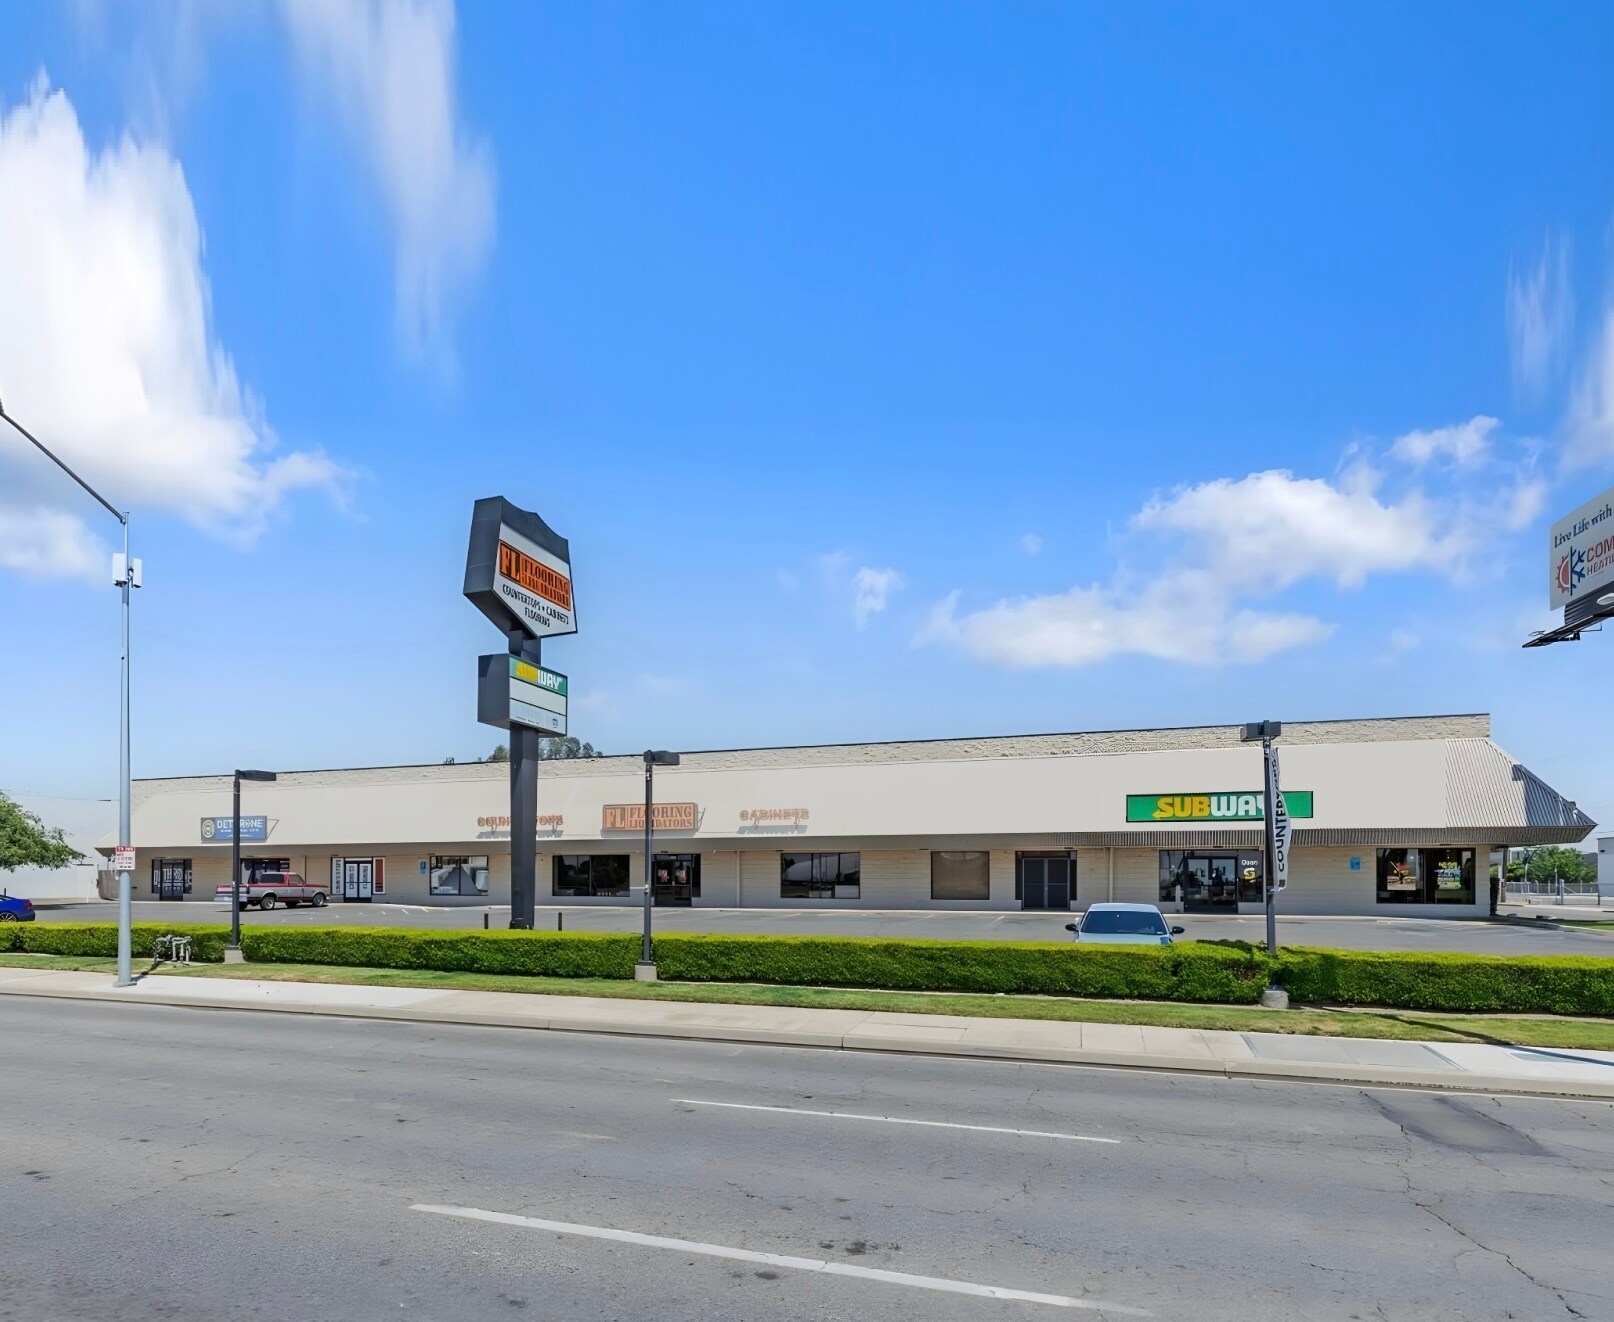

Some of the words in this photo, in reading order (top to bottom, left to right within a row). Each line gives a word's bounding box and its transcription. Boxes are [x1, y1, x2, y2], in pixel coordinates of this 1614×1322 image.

[1554, 532, 1572, 548] Live
[1573, 518, 1590, 537] Life
[1591, 504, 1612, 526] with
[521, 556, 569, 596] FLOORING
[515, 661, 562, 690] SUBWAY
[630, 806, 692, 819] FLORING
[217, 819, 264, 829] DETRONE
[477, 814, 564, 827] COUNOPS
[630, 818, 692, 829] LIQIDATORS
